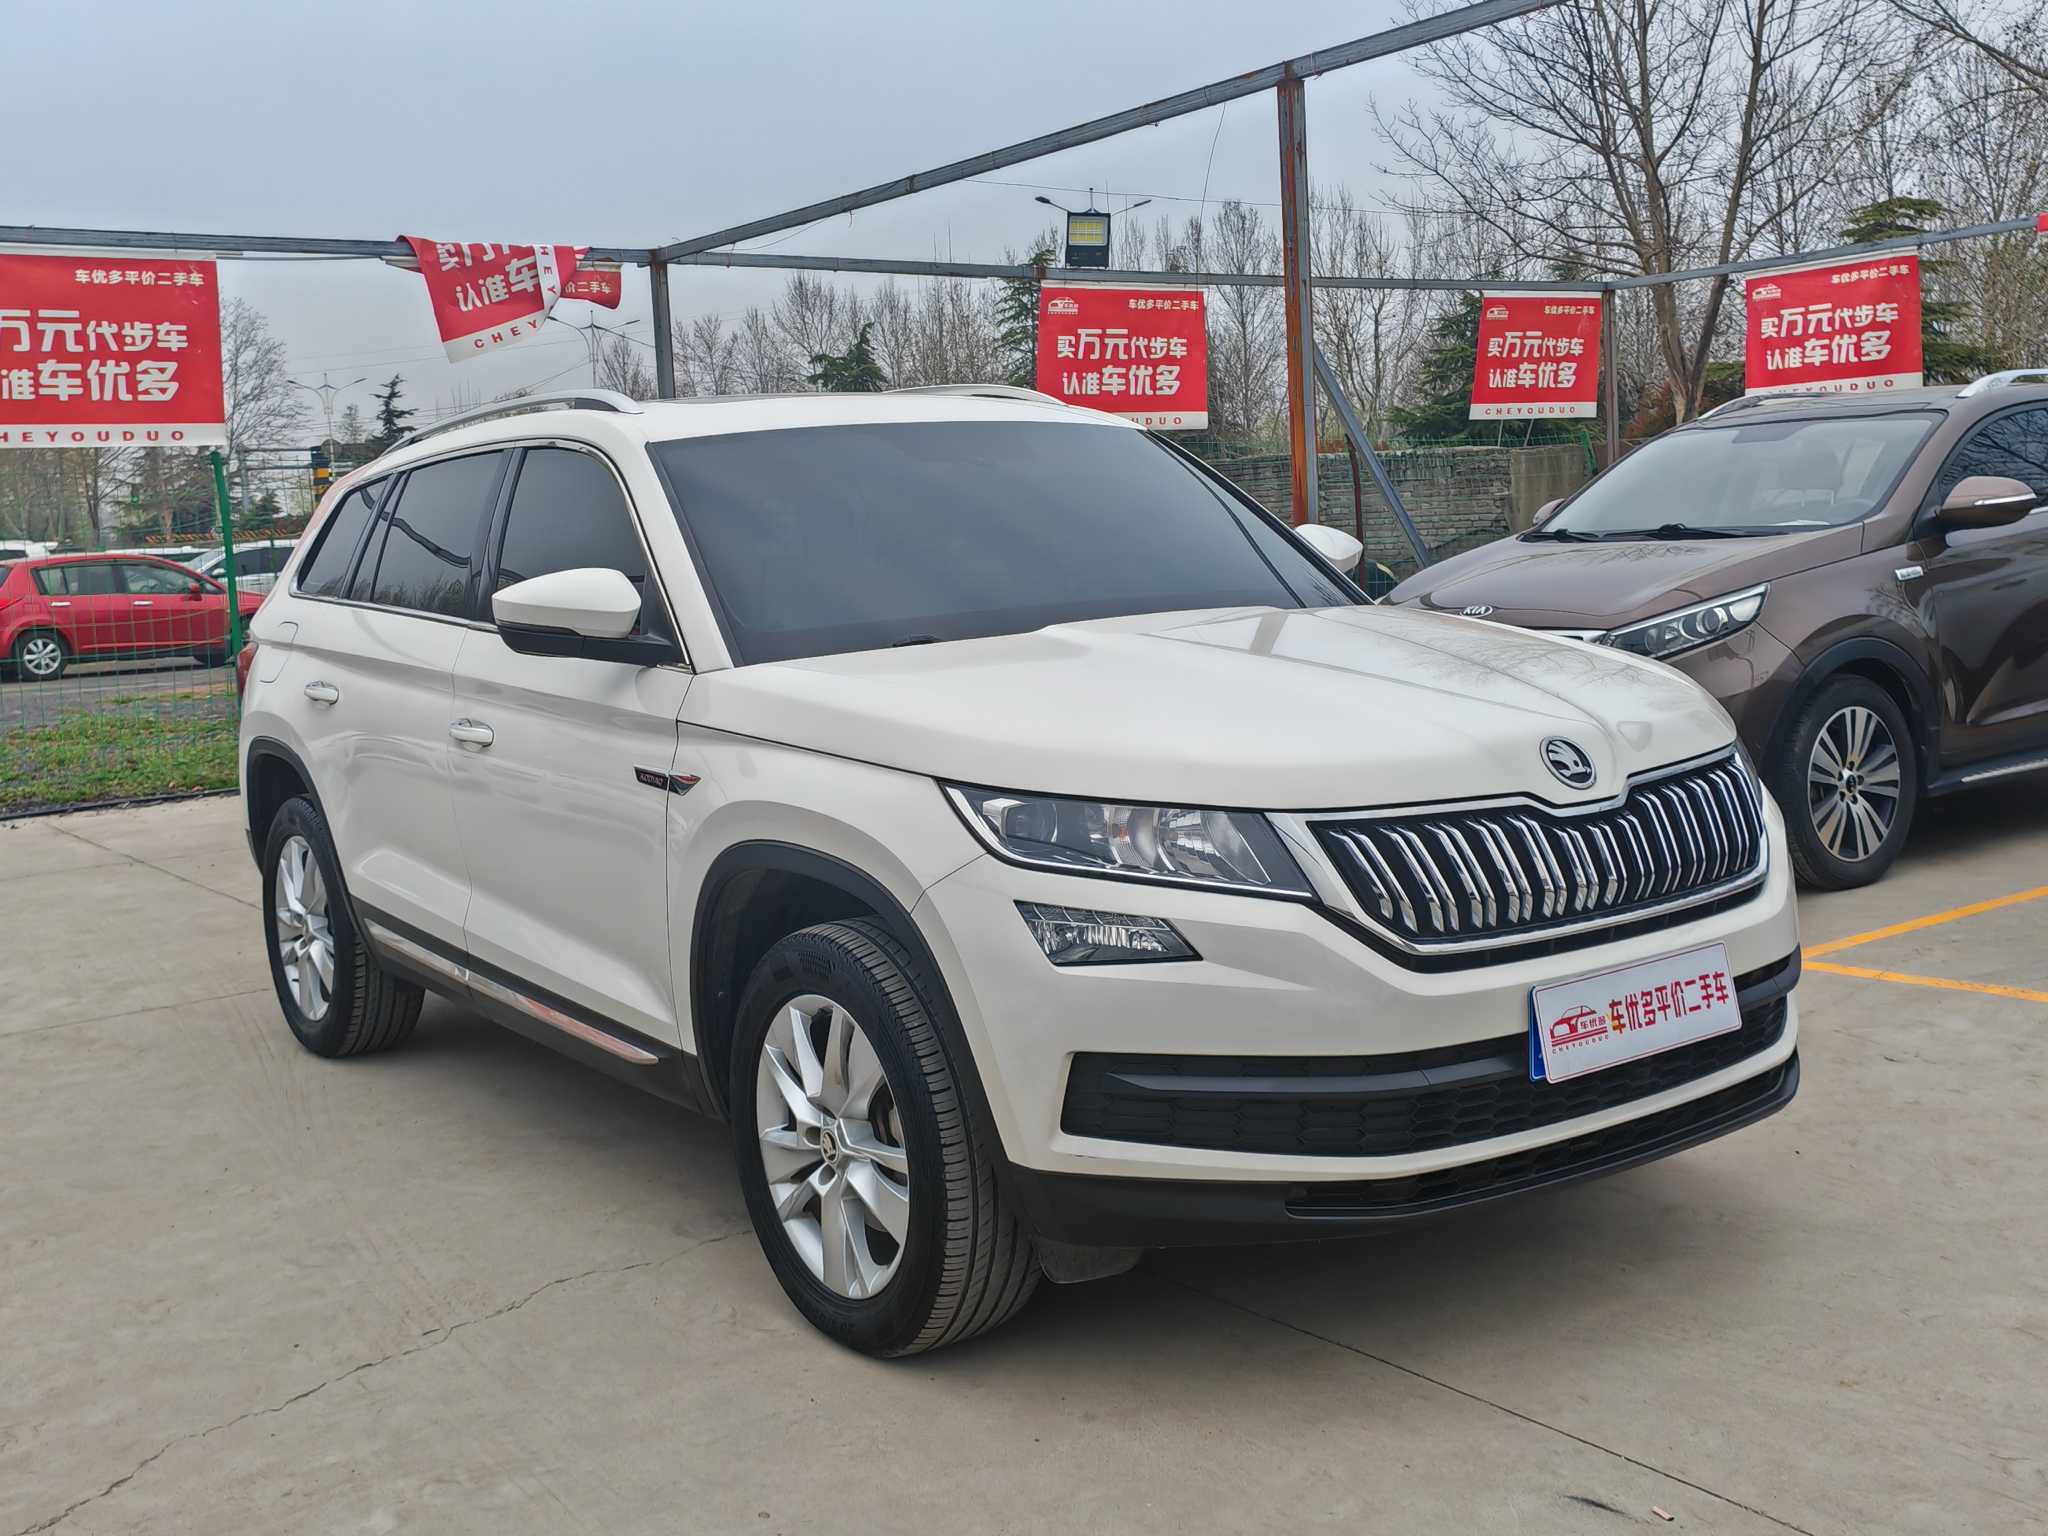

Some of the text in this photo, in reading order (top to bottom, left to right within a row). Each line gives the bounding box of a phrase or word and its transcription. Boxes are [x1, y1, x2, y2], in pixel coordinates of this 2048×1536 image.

[74, 269, 205, 287] 车优多平价二手车
[455, 256, 540, 312] 认准车
[1128, 299, 1199, 311] 车优多平价二手车
[1760, 302, 1899, 339] 买万元代步车
[474, 319, 538, 349] CHEY
[1057, 328, 1188, 360] 买万元代步车
[1487, 331, 1585, 358] 买万元代步车
[1766, 330, 1892, 371] 认准车优多
[0, 359, 180, 402] 准车优多
[1062, 364, 1181, 396] 认准车优多
[1488, 362, 1578, 389] 认准车优多
[1463, 605, 1487, 615] KIA
[1608, 971, 1730, 1034] 车优多平价二手车
